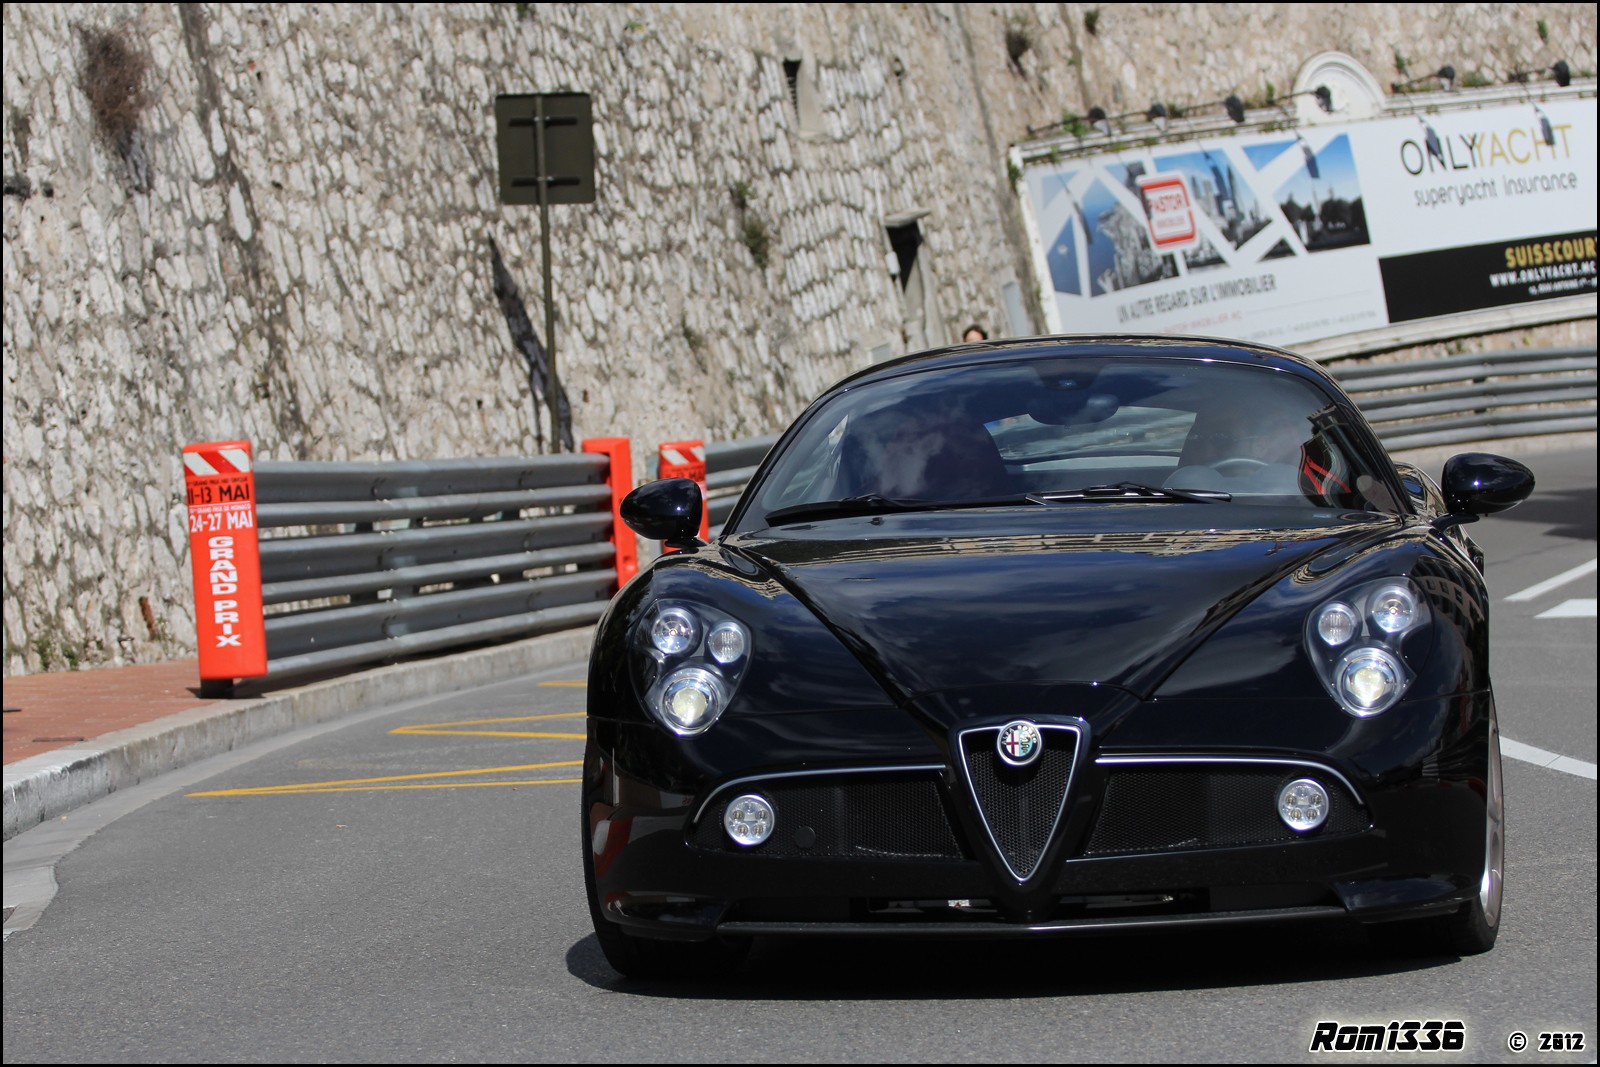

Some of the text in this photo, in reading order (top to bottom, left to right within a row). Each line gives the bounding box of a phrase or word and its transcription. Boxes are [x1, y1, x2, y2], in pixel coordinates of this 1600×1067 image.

[1414, 171, 1578, 208] superyacht insurance
[1505, 236, 1597, 269] SUISSCOUR
[1130, 297, 1154, 320] AUTRE
[1154, 289, 1188, 313] REGARD
[1189, 285, 1208, 305] SUR
[186, 483, 250, 505] 11-13 MAI
[189, 510, 253, 533] 24-27 MAI
[208, 536, 237, 595] GRAND
[214, 600, 242, 648] PRIX
